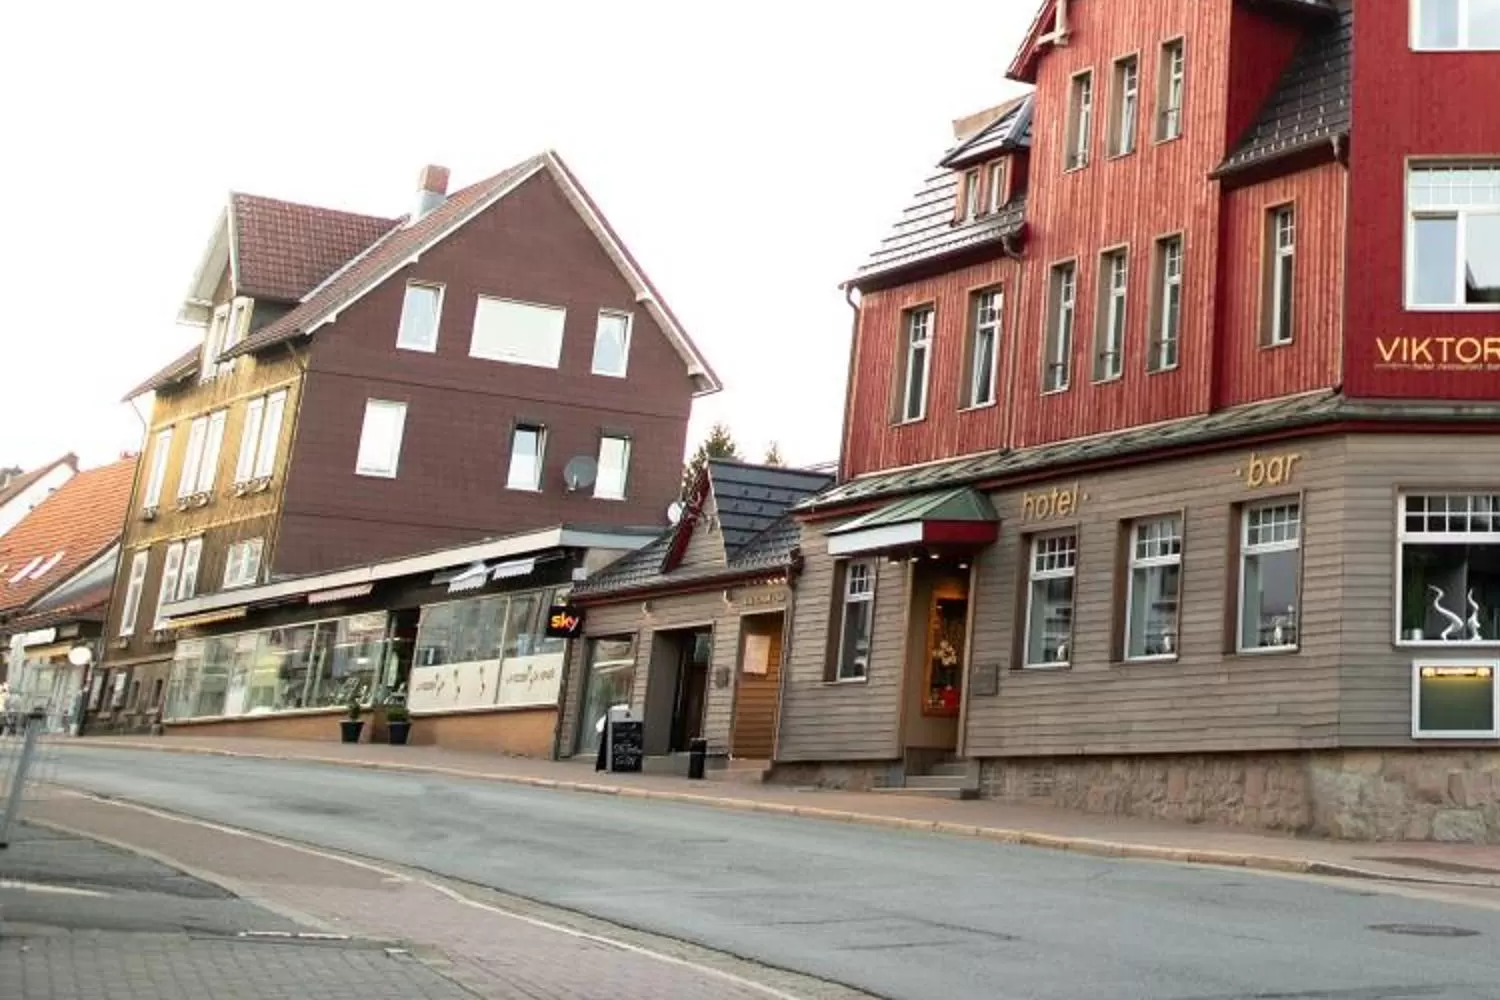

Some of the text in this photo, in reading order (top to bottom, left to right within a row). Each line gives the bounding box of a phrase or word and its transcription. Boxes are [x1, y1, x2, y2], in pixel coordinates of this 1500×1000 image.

[1021, 452, 1301, 520] hotel bar
[551, 611, 580, 632] sky
